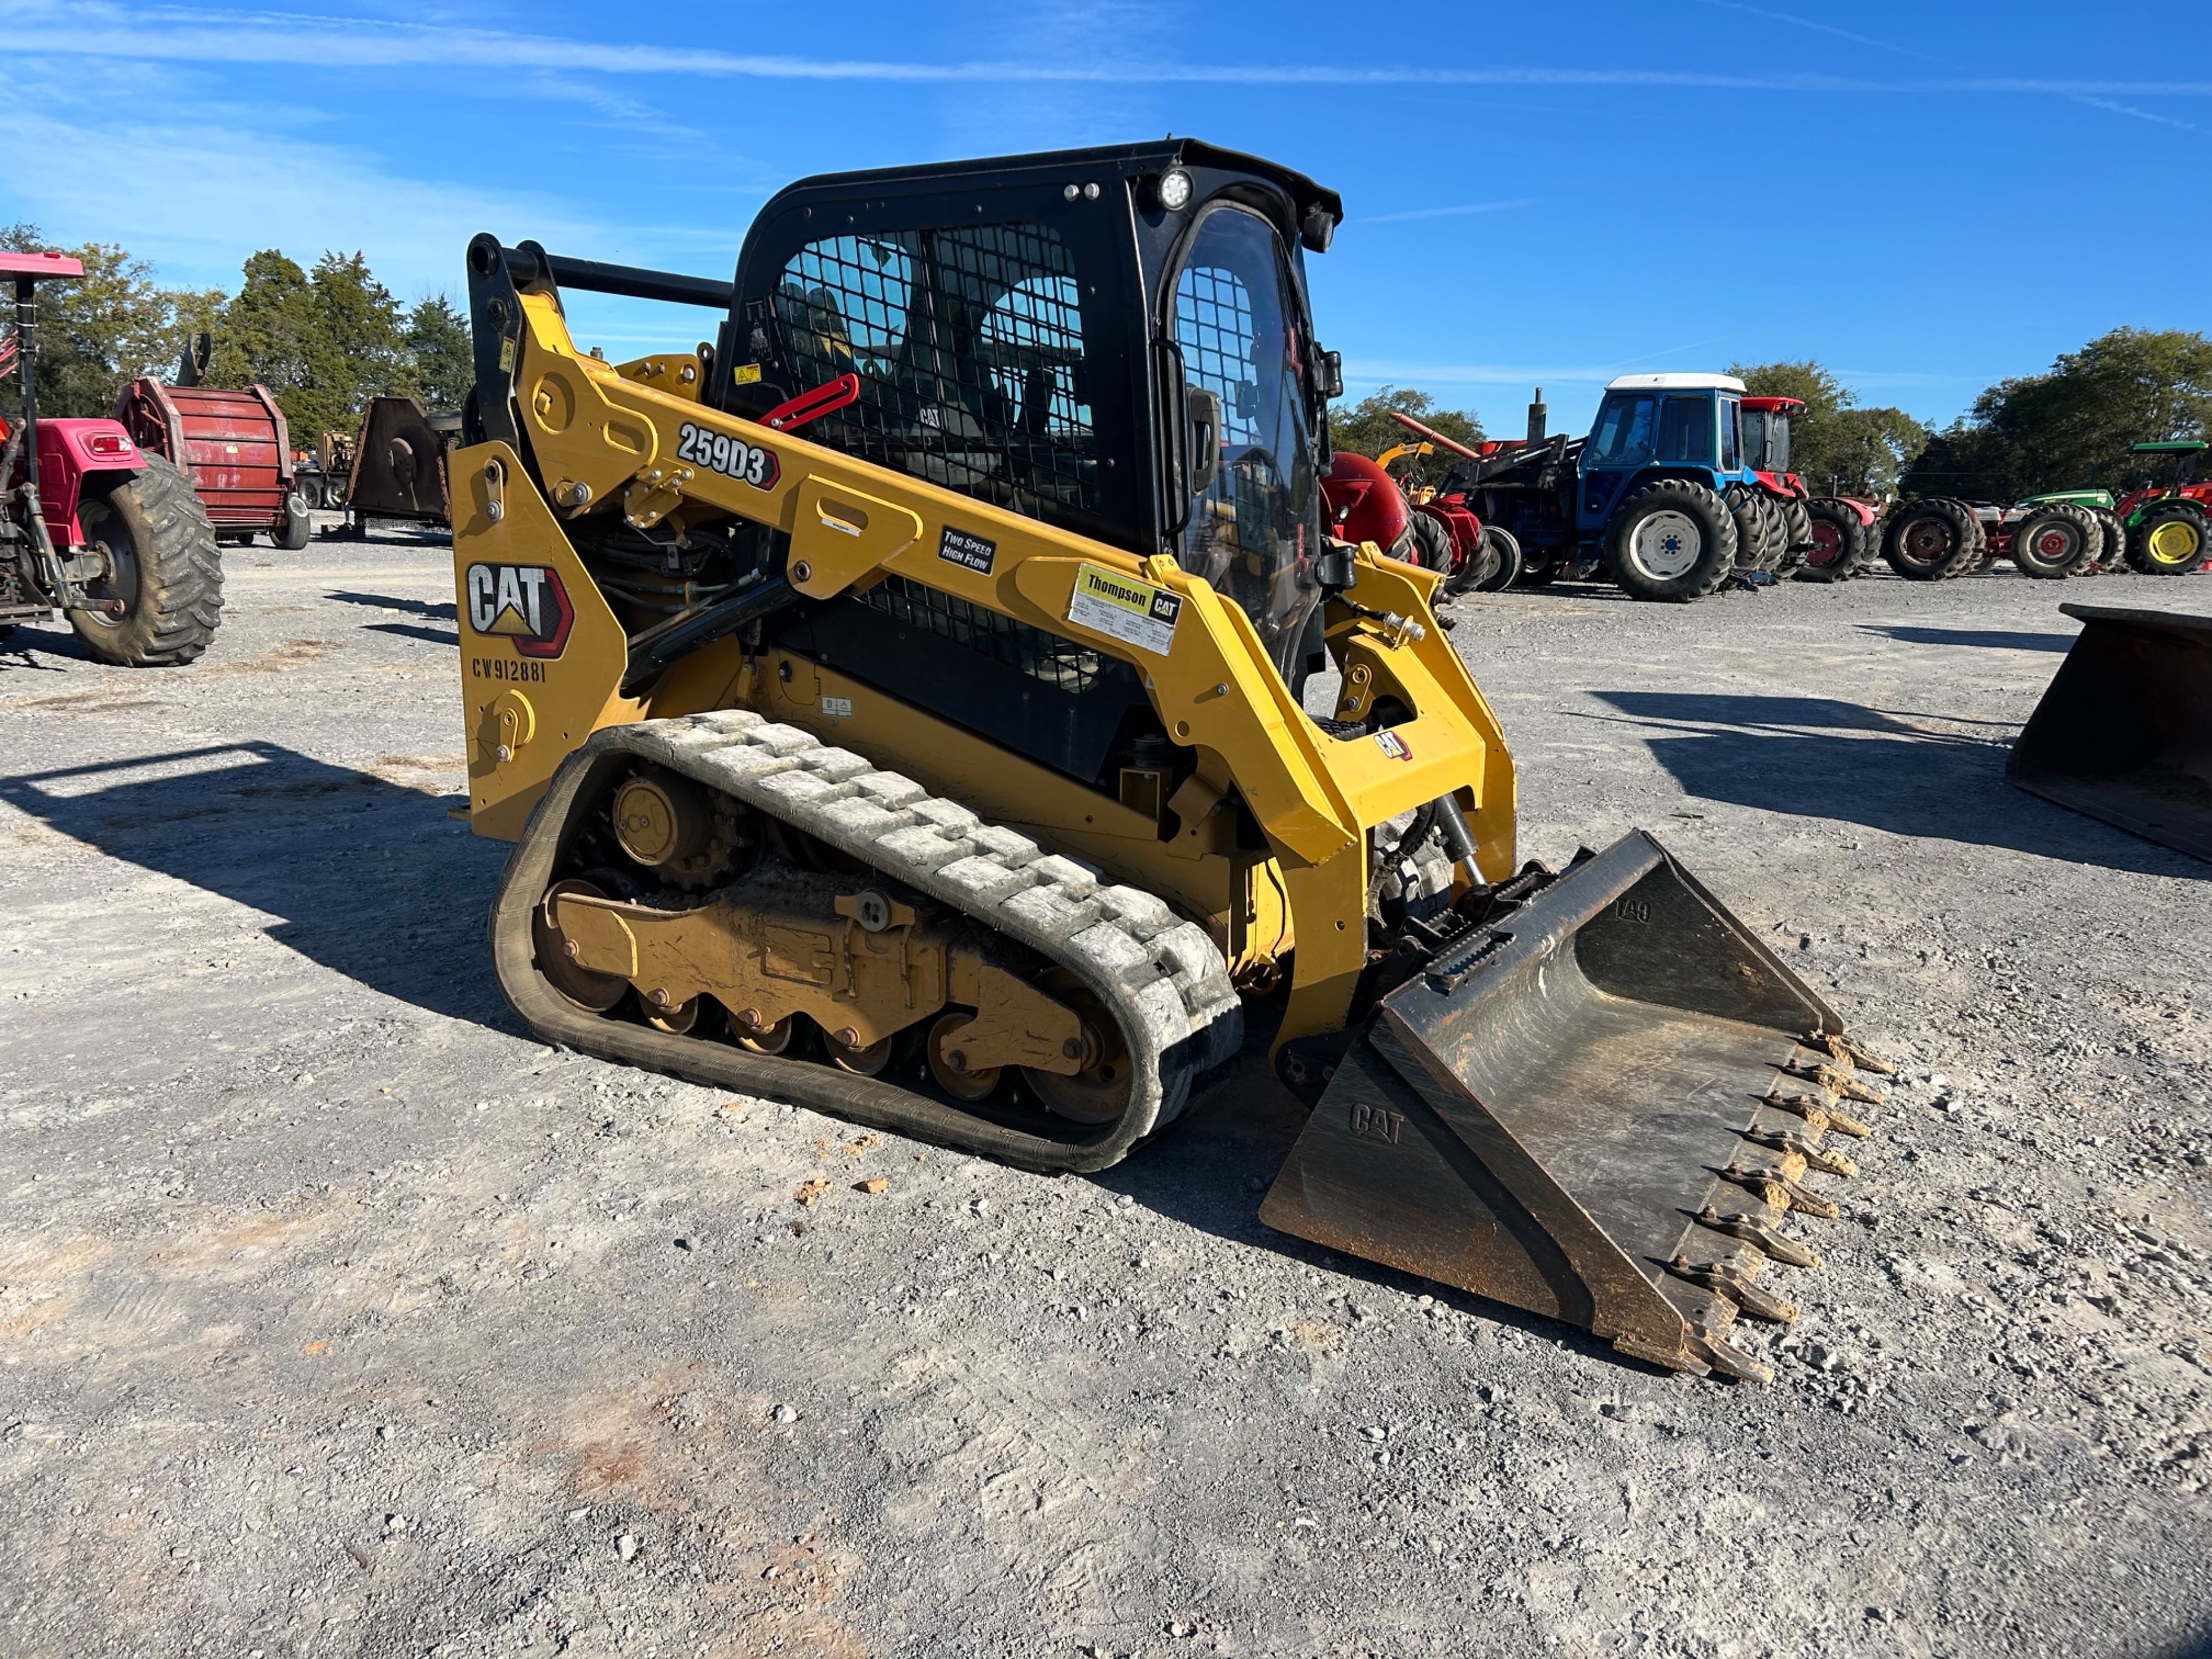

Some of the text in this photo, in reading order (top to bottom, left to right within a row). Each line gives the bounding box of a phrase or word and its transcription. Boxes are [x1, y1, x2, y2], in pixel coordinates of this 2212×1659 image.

[919, 408, 940, 428] CAT
[678, 424, 765, 484] 259D3
[468, 564, 545, 636] CAT
[1088, 574, 1146, 607] Thompson
[1154, 598, 1177, 617] CAT
[472, 658, 546, 683] CW912881
[1374, 732, 1405, 758] CAT
[1350, 1103, 1405, 1145] CAT
